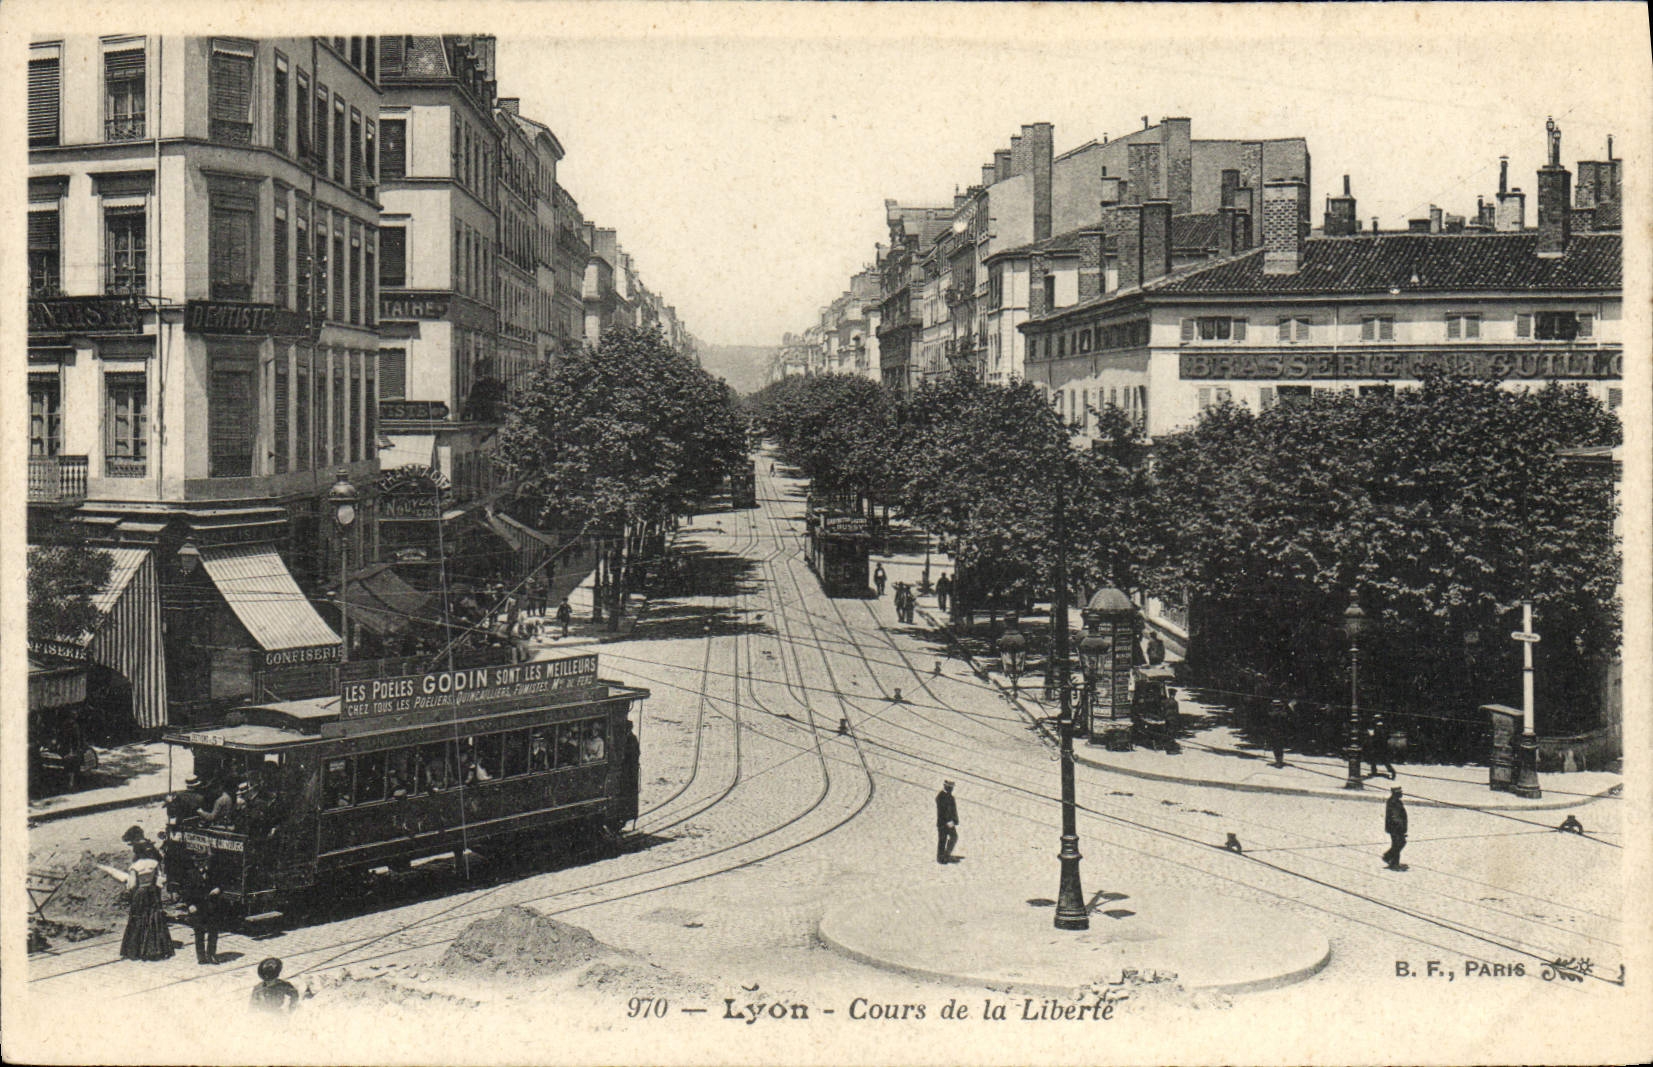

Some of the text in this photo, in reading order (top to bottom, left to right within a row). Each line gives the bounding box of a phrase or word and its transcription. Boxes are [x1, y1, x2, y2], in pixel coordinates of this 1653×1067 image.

[191, 304, 272, 329] DENTISTE
[1187, 353, 1400, 378] BRASSERIE
[265, 645, 345, 666] CONFISERIE
[345, 684, 366, 703] LES
[422, 668, 488, 694] GODIN
[495, 667, 521, 685] SONT
[525, 665, 542, 681] LES
[546, 657, 596, 678] MEILLEURS
[347, 703, 369, 717] CHEZ
[373, 701, 393, 713] TOUS
[396, 699, 410, 711] LES
